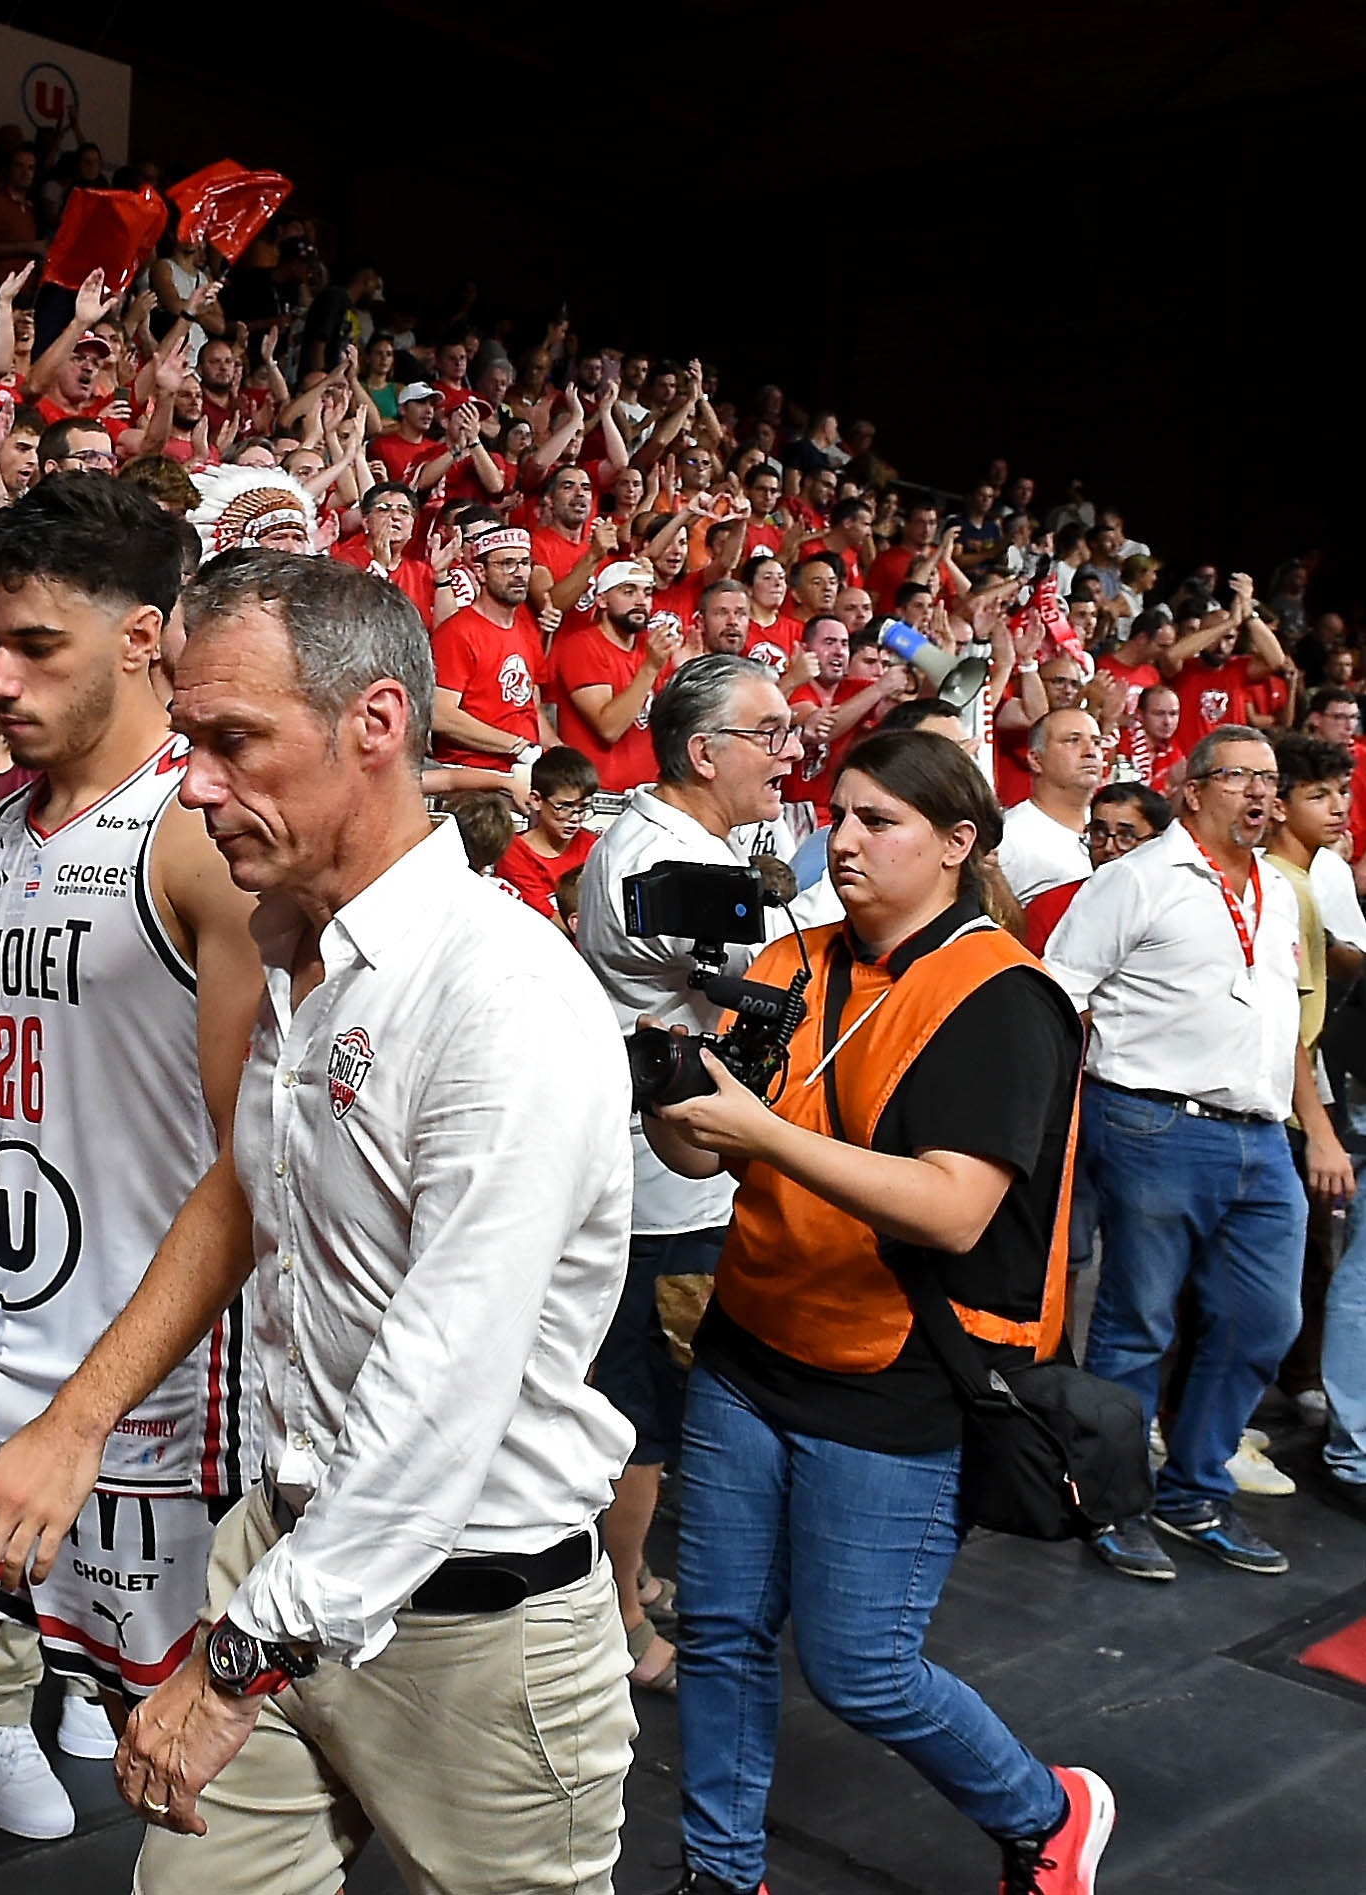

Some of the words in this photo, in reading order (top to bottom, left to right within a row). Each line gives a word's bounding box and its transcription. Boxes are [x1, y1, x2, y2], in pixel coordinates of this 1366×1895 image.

[53, 884, 127, 899] agglomération
[327, 1043, 373, 1093] CHOLET
[73, 1558, 160, 1593] CHOLET
